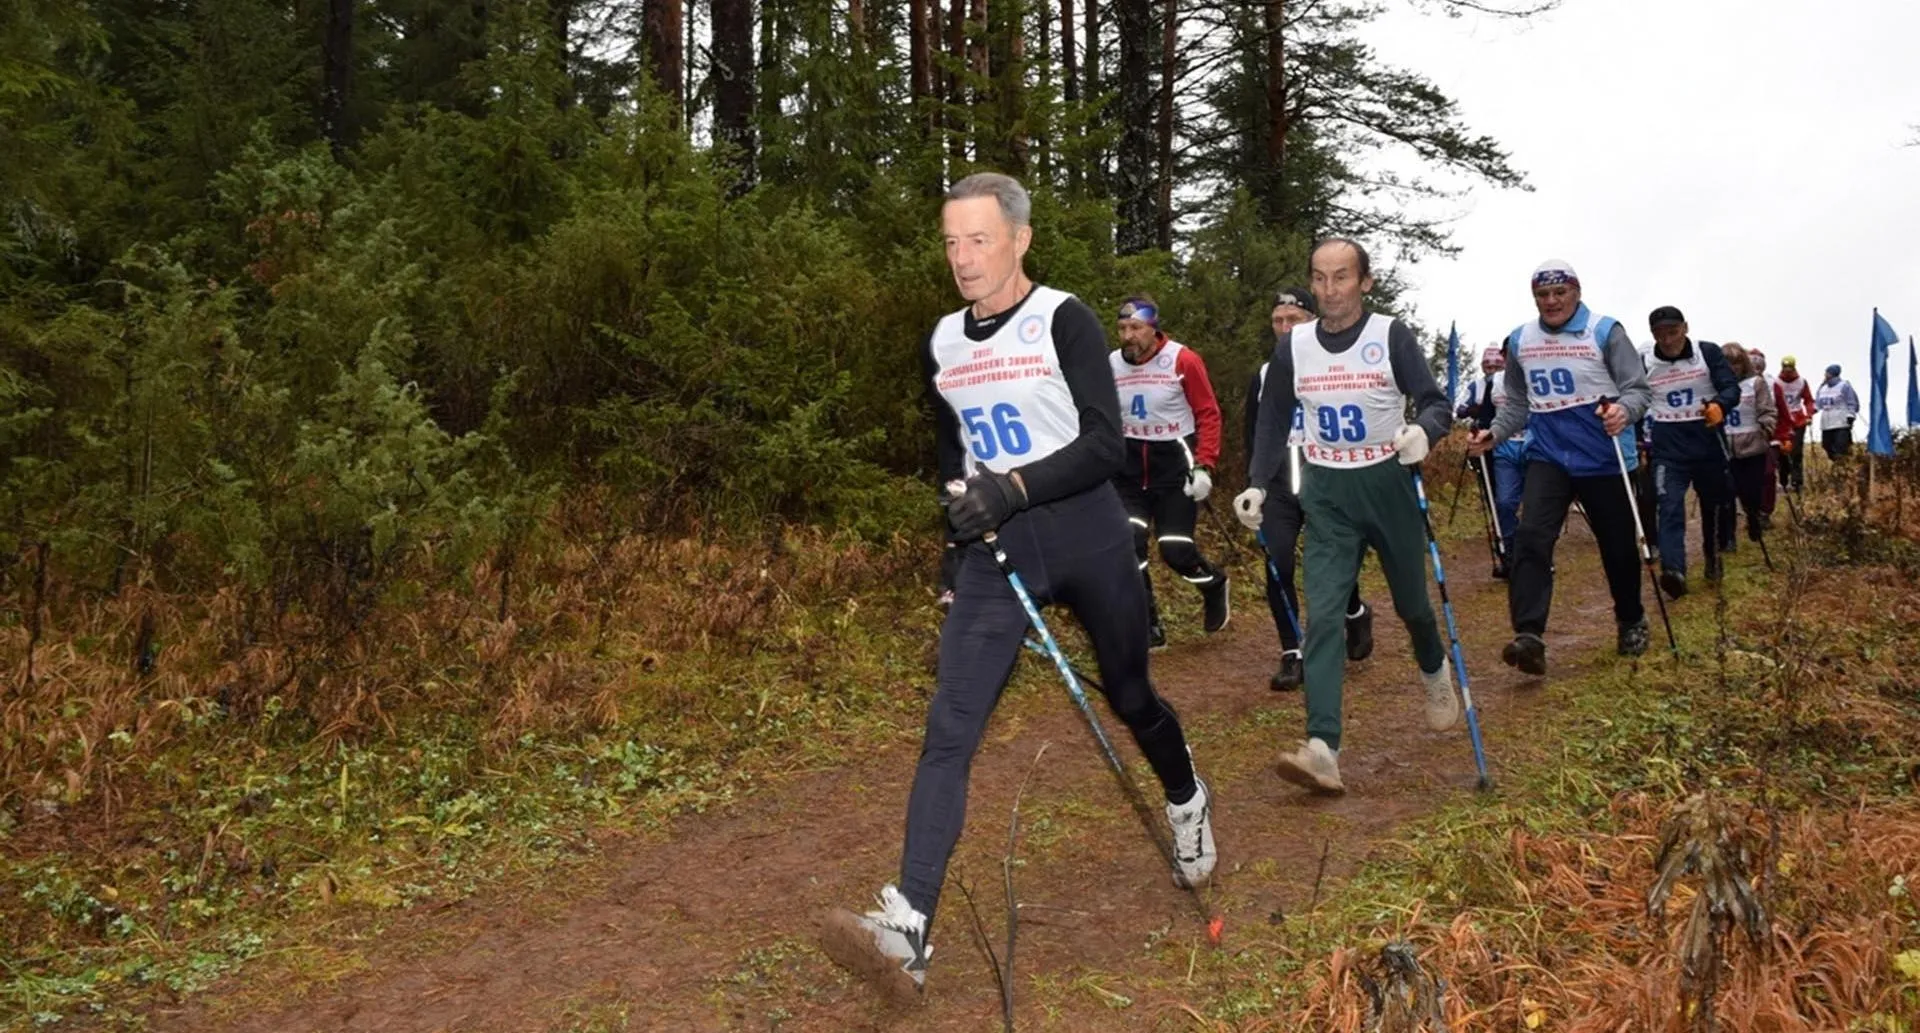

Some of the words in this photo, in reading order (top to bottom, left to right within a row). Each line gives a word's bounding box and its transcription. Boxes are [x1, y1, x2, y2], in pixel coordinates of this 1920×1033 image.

[1530, 367, 1575, 396] 59
[1131, 394, 1148, 420] 4
[1666, 388, 1693, 407] 67
[961, 402, 1032, 460] 56
[1318, 404, 1366, 442] 93
[1725, 410, 1741, 427] 8
